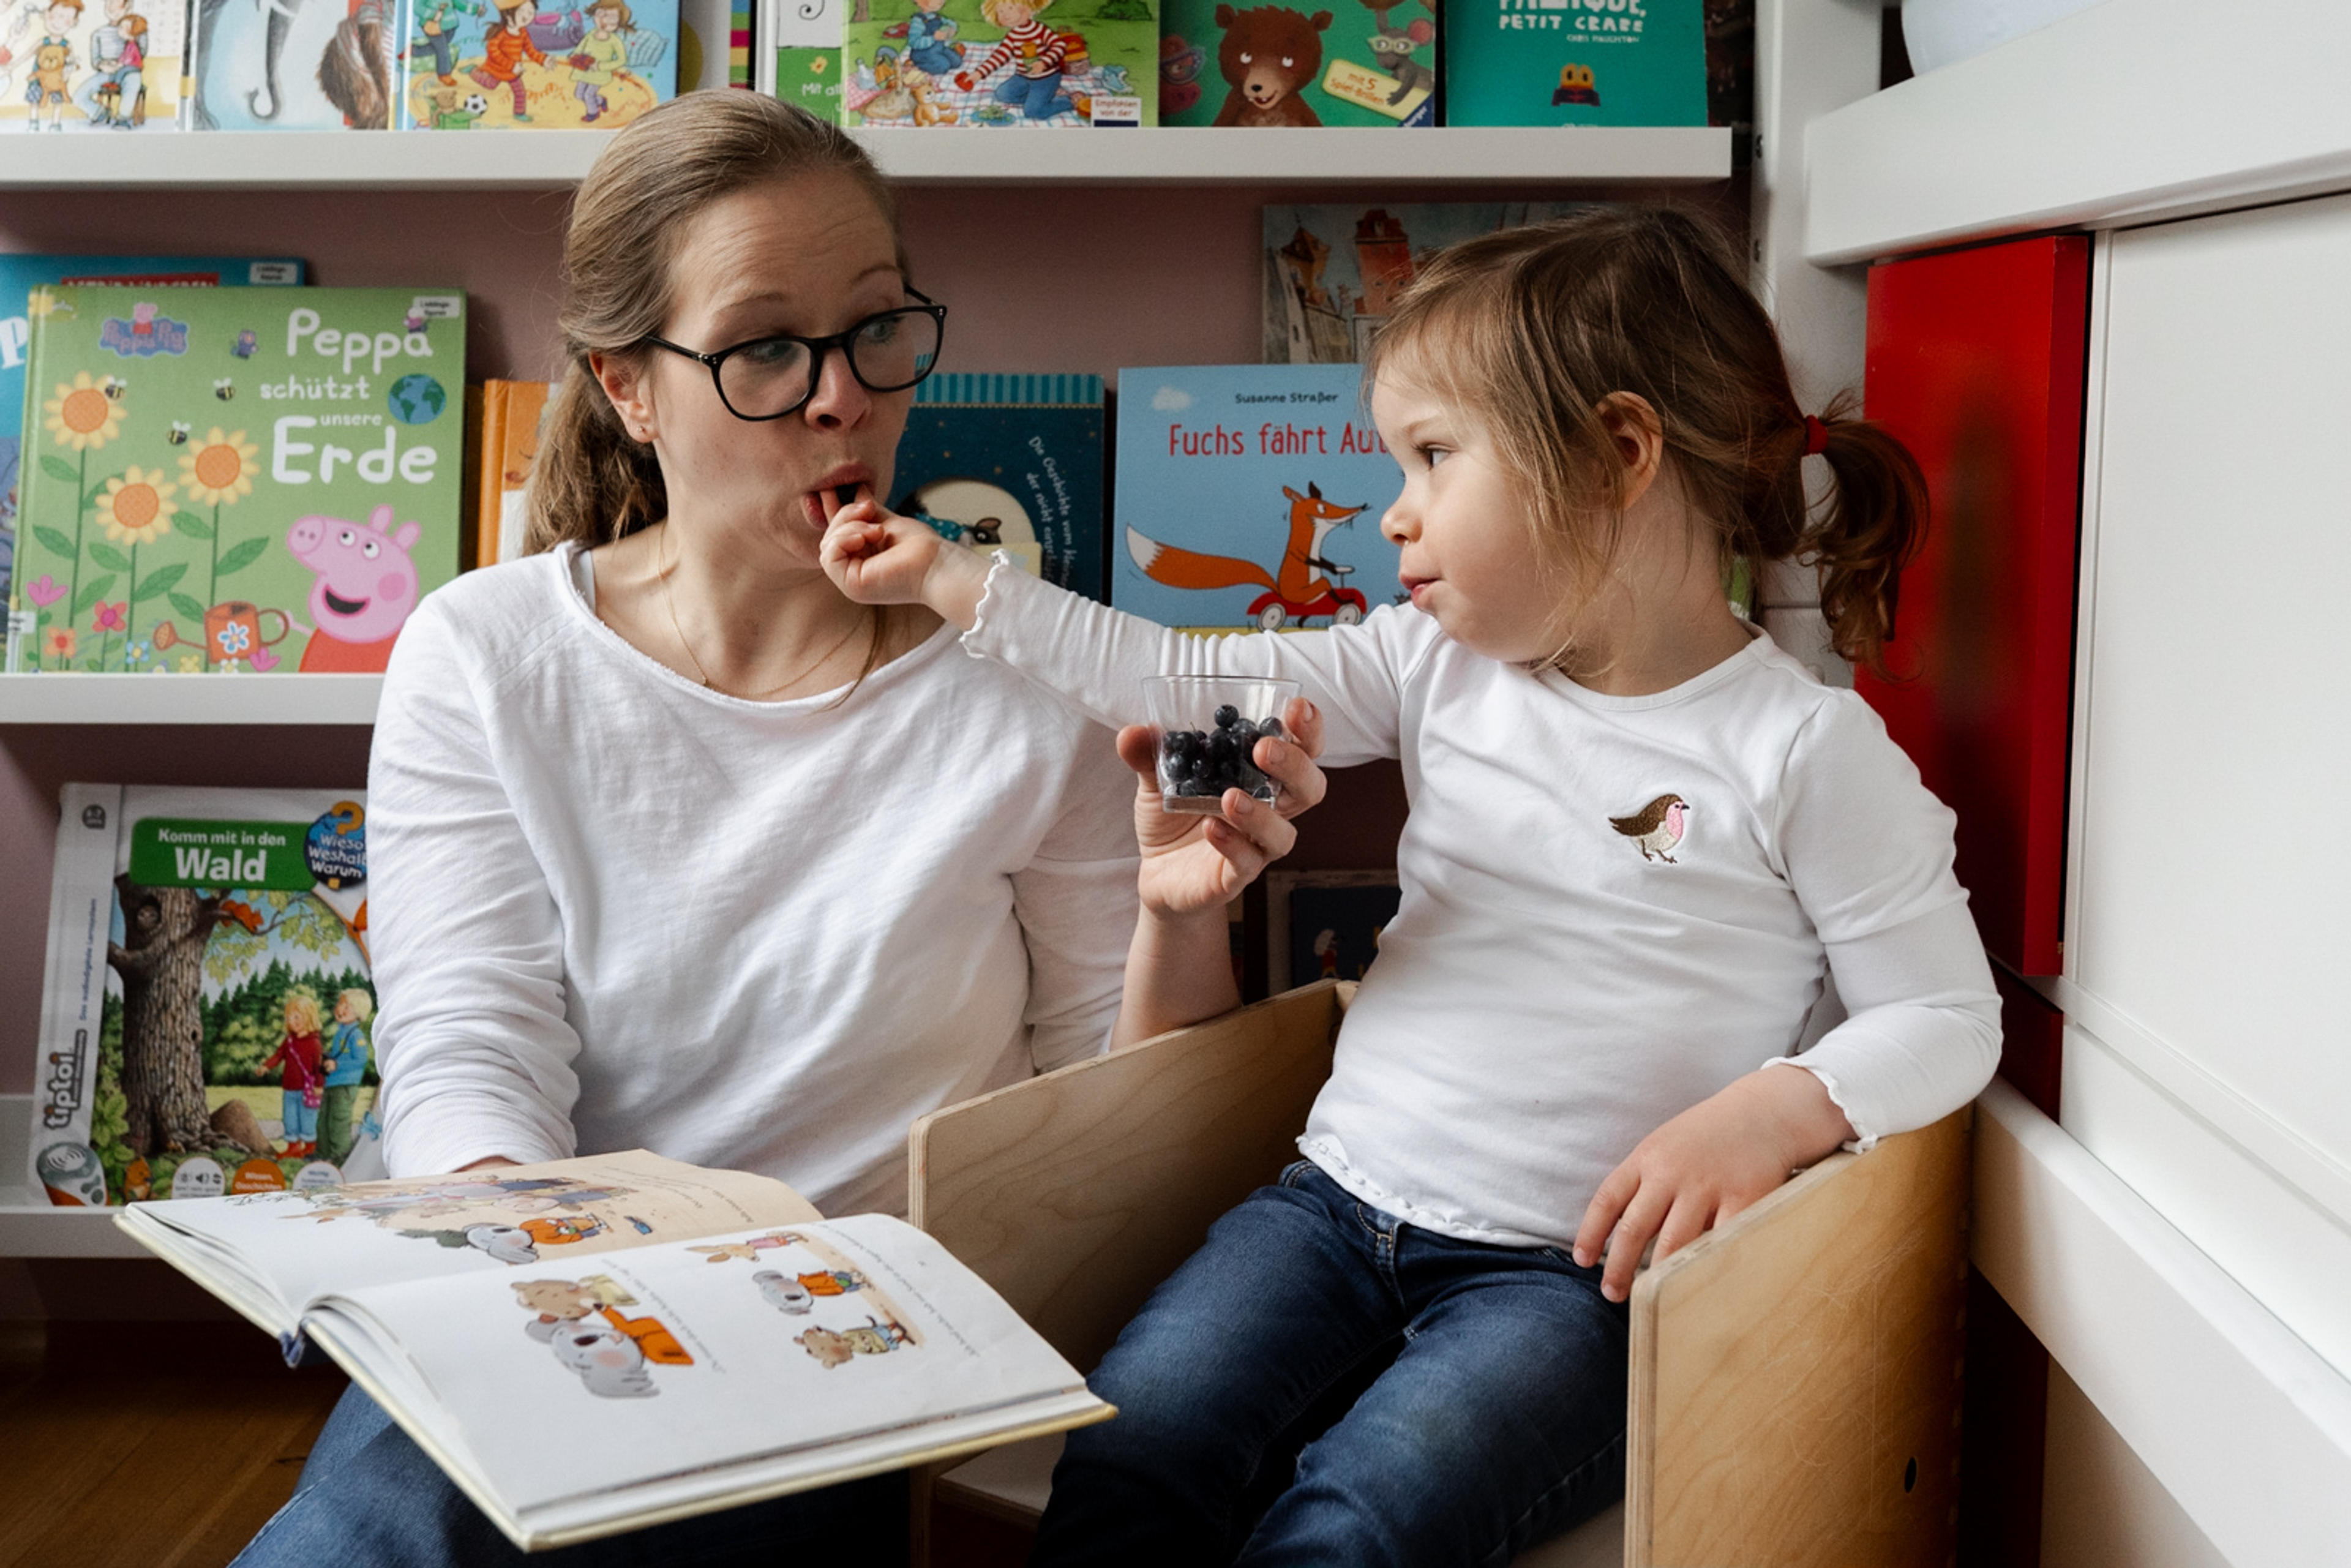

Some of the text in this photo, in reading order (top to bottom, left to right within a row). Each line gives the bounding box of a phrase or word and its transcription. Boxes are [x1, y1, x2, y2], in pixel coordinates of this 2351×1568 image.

[1499, 14, 1644, 32] PETIT CRABE
[802, 83, 822, 97] Mit
[1348, 73, 1377, 91] mit 5
[1095, 99, 1138, 108] Empfohlen
[287, 308, 433, 375] Peppa
[260, 374, 370, 399] schützt
[1235, 394, 1286, 404] Susanne
[320, 414, 383, 426] unsere
[1169, 421, 1389, 456] Fuchs fährt Aut
[272, 415, 438, 484] Erde
[1029, 436, 1044, 456] Die
[1043, 456, 1071, 516] Geschichte
[1026, 472, 1040, 490] der
[1035, 492, 1054, 522] nicht
[158, 828, 287, 846] Komm mit in den
[320, 833, 364, 851] Wieso
[174, 846, 267, 882] Wald
[311, 859, 362, 879] Warum
[43, 1052, 80, 1130] tiptoi
